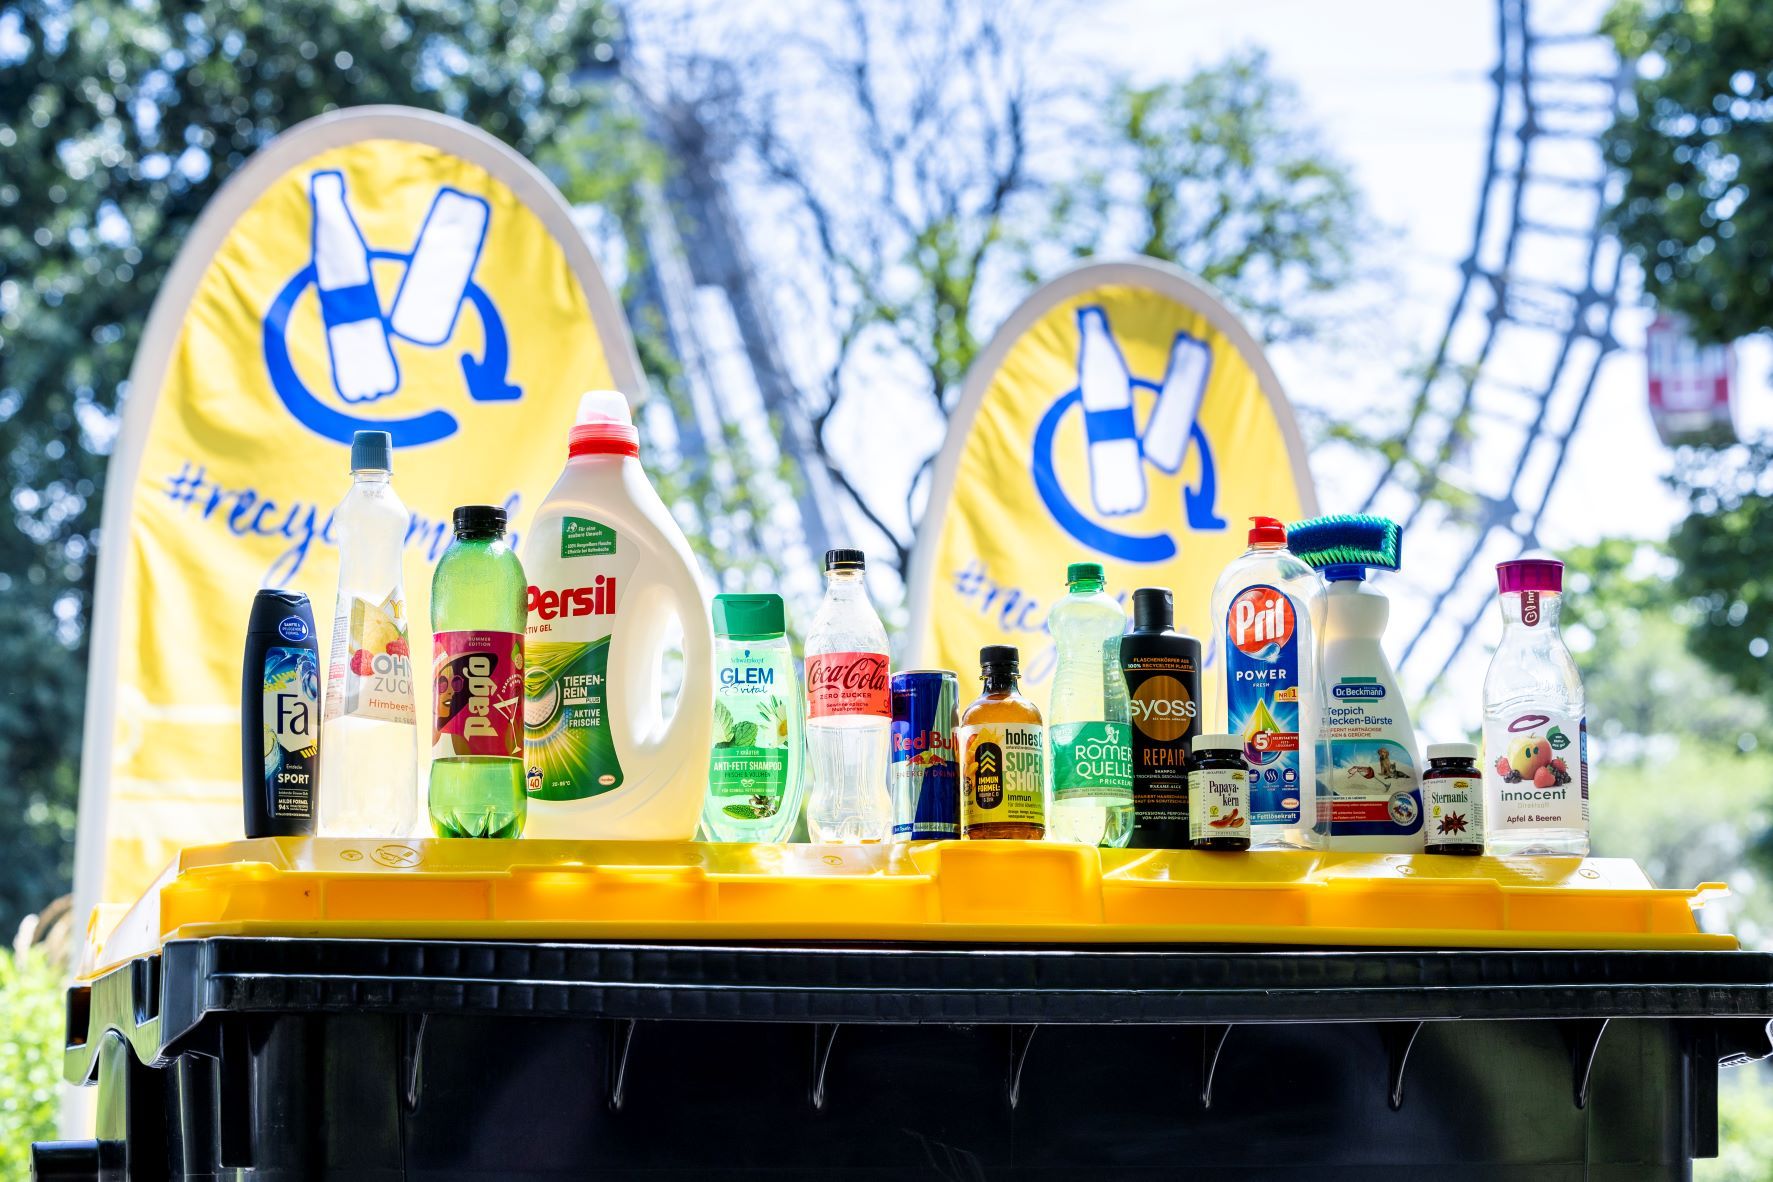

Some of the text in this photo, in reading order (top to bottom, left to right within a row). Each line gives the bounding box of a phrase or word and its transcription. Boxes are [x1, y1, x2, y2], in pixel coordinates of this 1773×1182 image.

[1236, 597, 1285, 646] Pril
[540, 624, 552, 632] GEL
[564, 675, 604, 687] TIEFEN-
[720, 667, 774, 684] GLEM
[808, 658, 887, 693] Coca-Cola
[1236, 669, 1287, 681] POWER
[564, 687, 588, 698] REIN
[740, 684, 767, 694] vital
[1292, 689, 1296, 698] 1
[463, 656, 498, 742] pago
[277, 693, 309, 735] Fa
[574, 708, 600, 718] AKTIVE
[1130, 700, 1196, 722] syoss
[569, 718, 600, 728] FRISCHE
[893, 730, 926, 752] Red
[1144, 748, 1186, 766] REPAIR
[714, 762, 782, 770] ANTI-FETT SHAMPOO
[1076, 761, 1132, 780] QUELLE
[278, 774, 310, 784] SPORT
[896, 770, 928, 778] ENERGY
[978, 776, 998, 784] IMMUN
[530, 778, 540, 788] 40
[1209, 780, 1240, 796] Papaya-
[1222, 794, 1240, 806] kern
[1432, 791, 1468, 804] Sternanis
[1501, 788, 1566, 801] innocent
